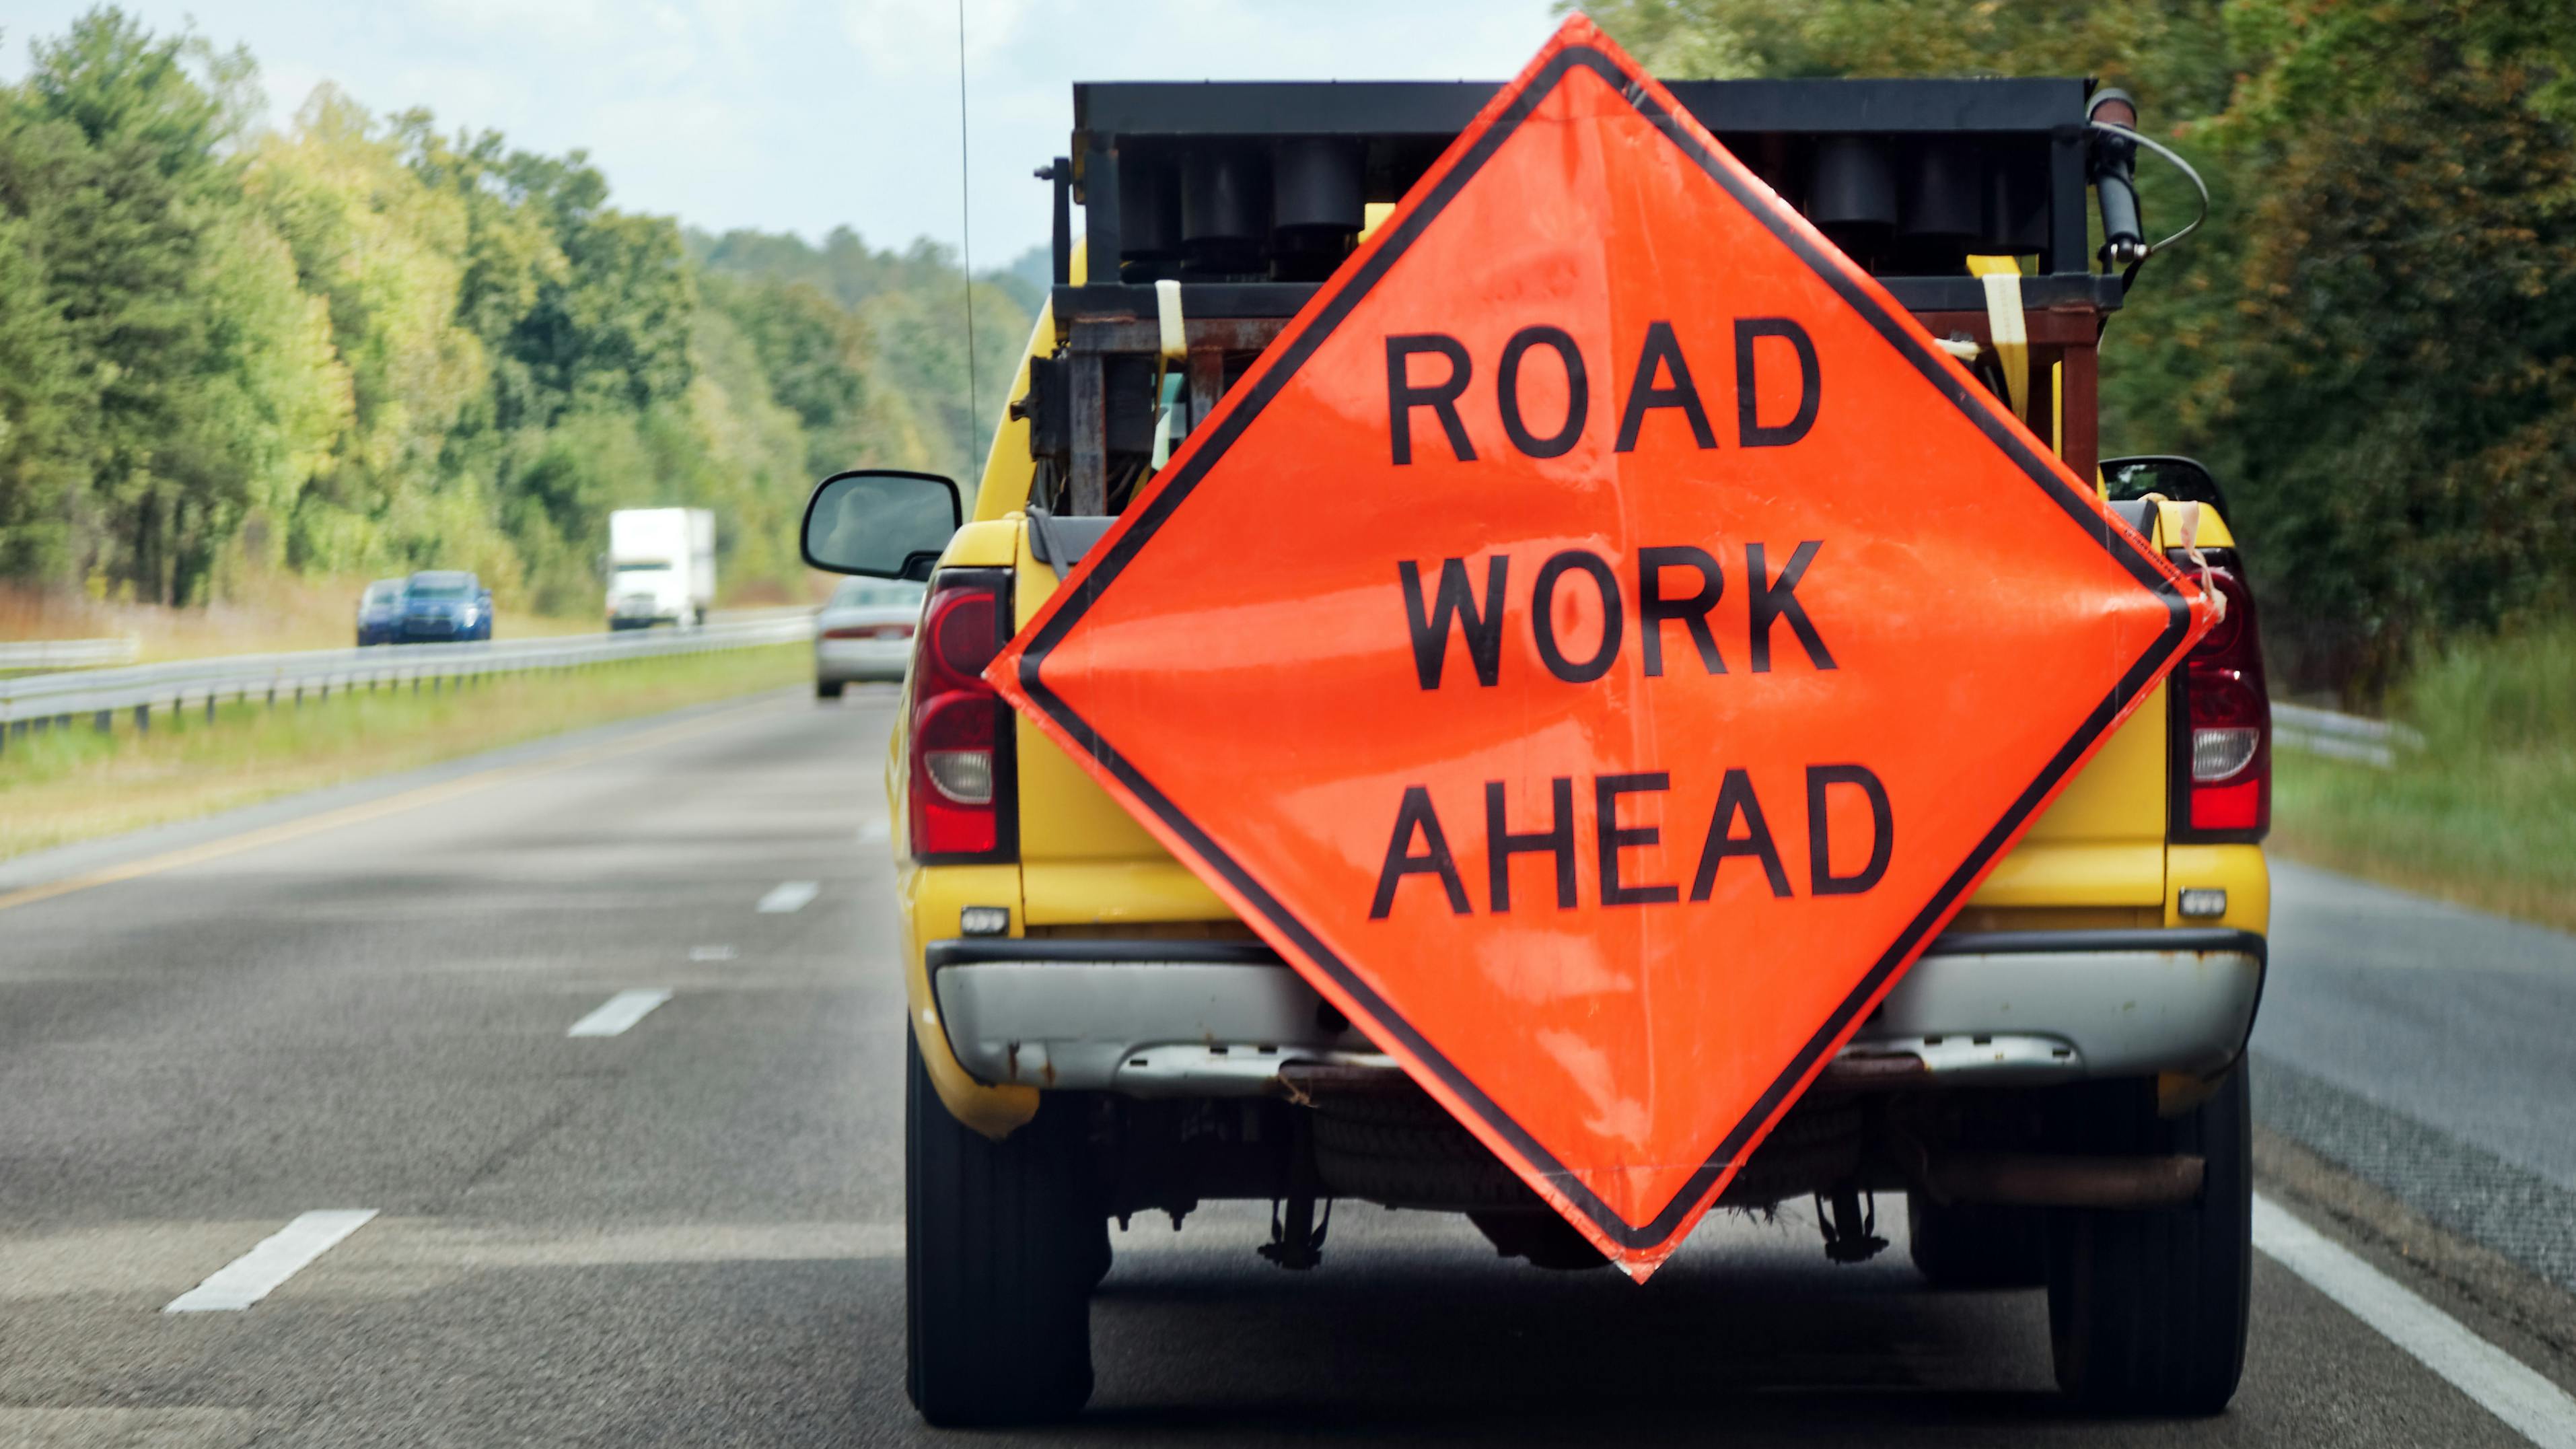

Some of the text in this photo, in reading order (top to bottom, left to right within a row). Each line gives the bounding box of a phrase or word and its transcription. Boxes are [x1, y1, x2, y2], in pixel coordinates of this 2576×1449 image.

[1386, 318, 1821, 466] ROAD
[1398, 541, 1838, 691] WORK
[1369, 765, 1894, 921] AHEAD
